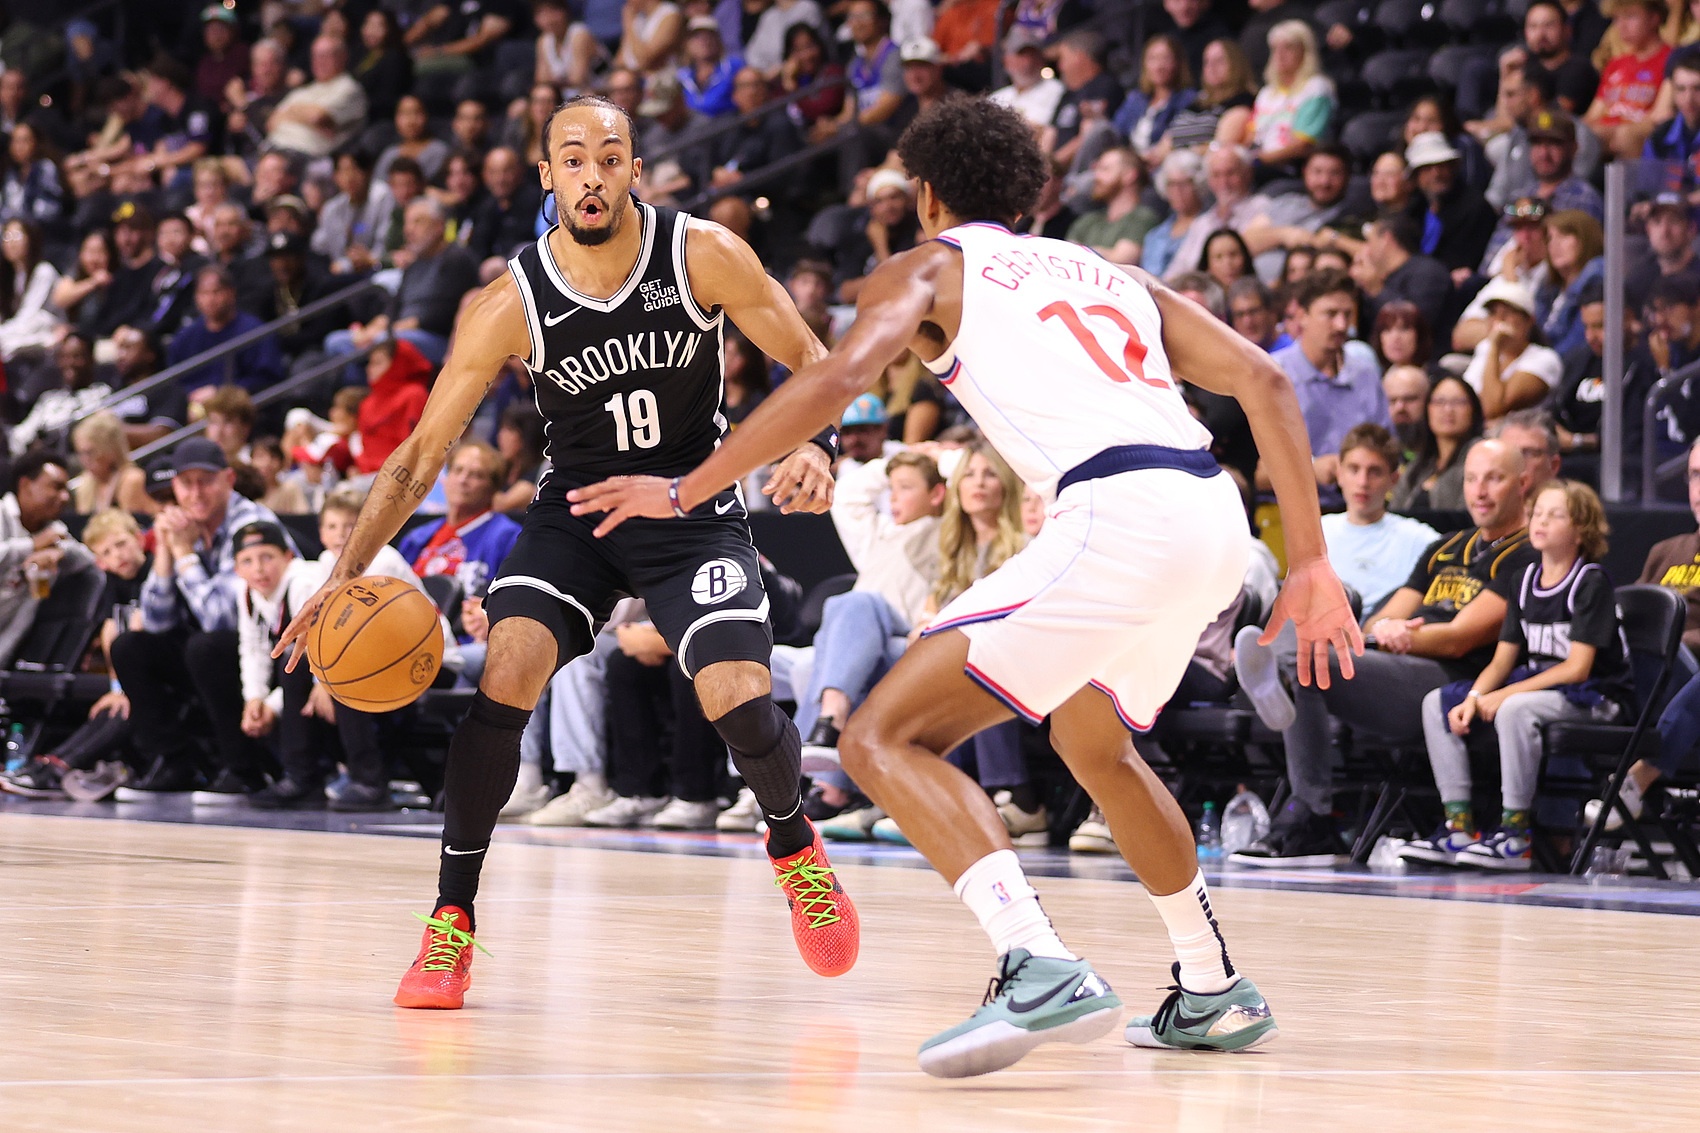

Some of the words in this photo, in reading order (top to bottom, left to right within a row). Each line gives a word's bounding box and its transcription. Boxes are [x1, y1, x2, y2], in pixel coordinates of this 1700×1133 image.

[639, 279, 661, 293] GET
[641, 286, 676, 302] YOUR
[643, 294, 681, 312] GUIDE
[1036, 300, 1172, 390] 12
[544, 330, 702, 396] BROOKLYN
[604, 389, 661, 451] 19
[709, 565, 727, 598] B
